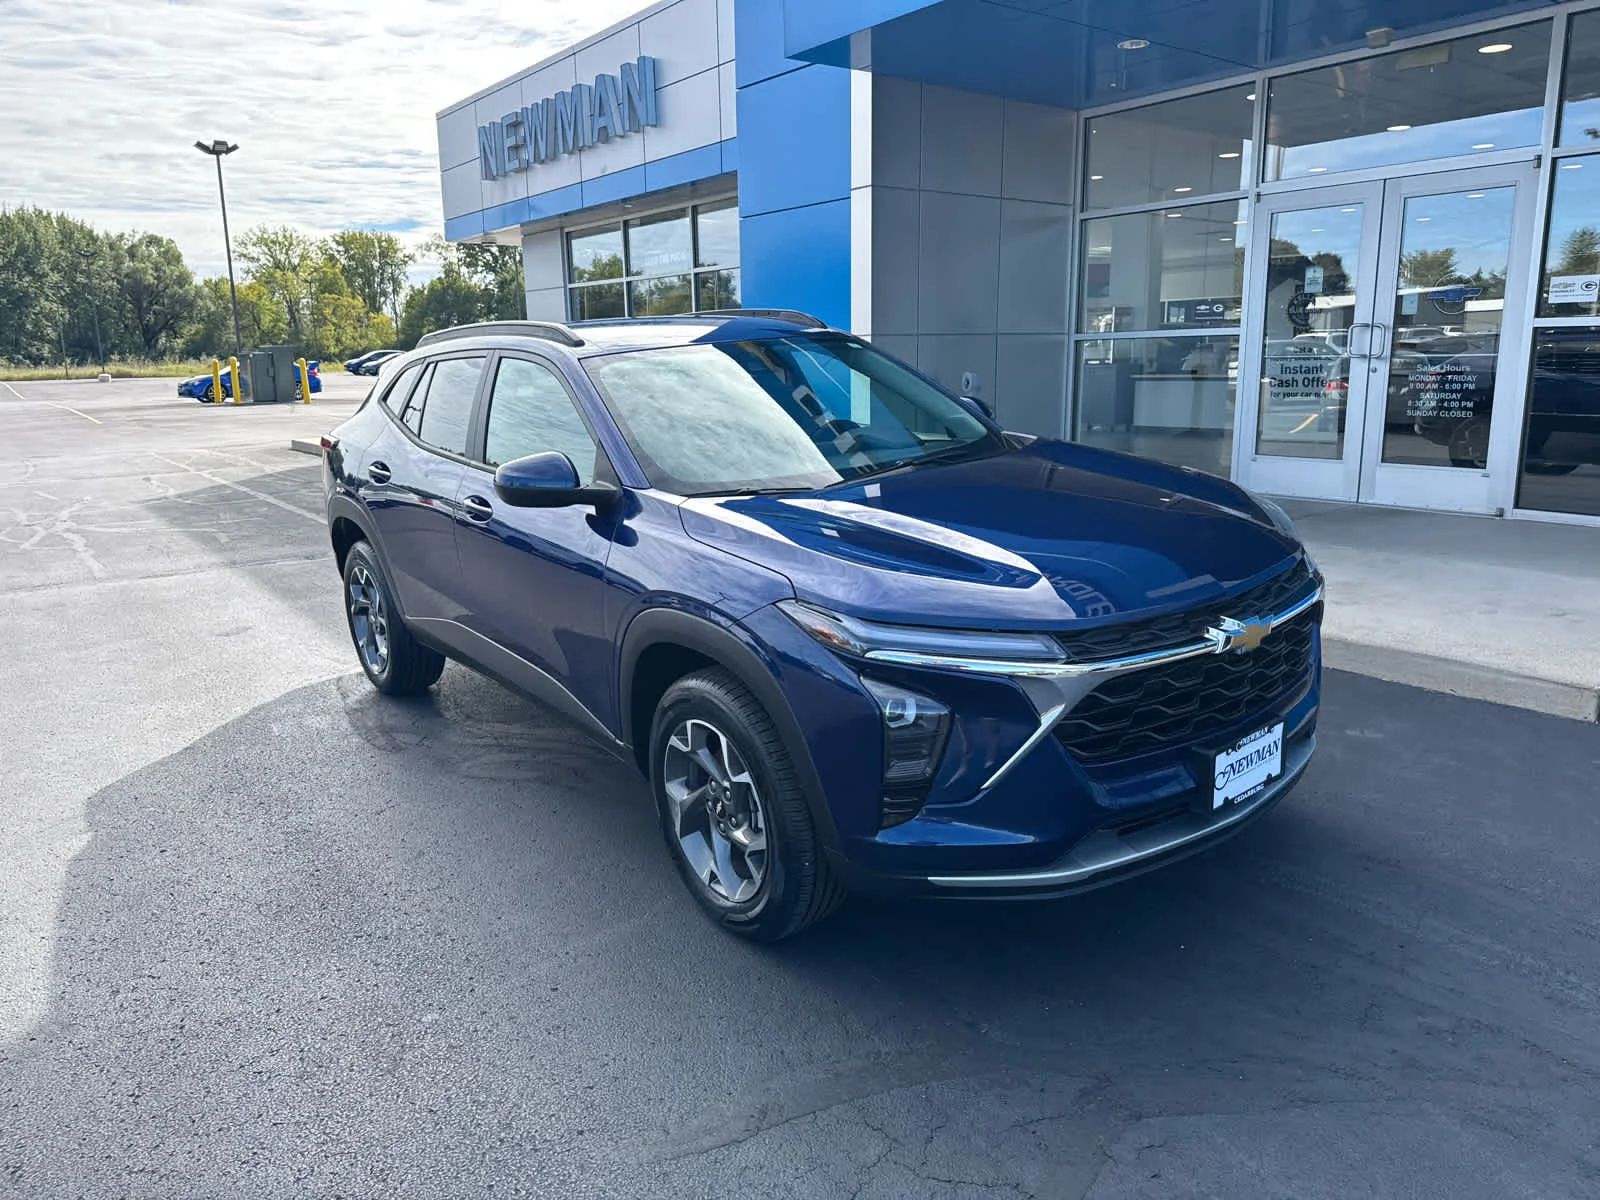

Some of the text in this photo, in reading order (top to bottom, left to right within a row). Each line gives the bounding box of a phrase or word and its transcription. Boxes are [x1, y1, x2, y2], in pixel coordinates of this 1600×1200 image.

[478, 55, 657, 180] NEWMAN
[1280, 364, 1324, 374] Instant
[1416, 364, 1472, 372] Sales Hours
[1269, 377, 1328, 388] Cash Offe
[1282, 391, 1298, 399] your
[1214, 738, 1280, 790] NEWMAN
